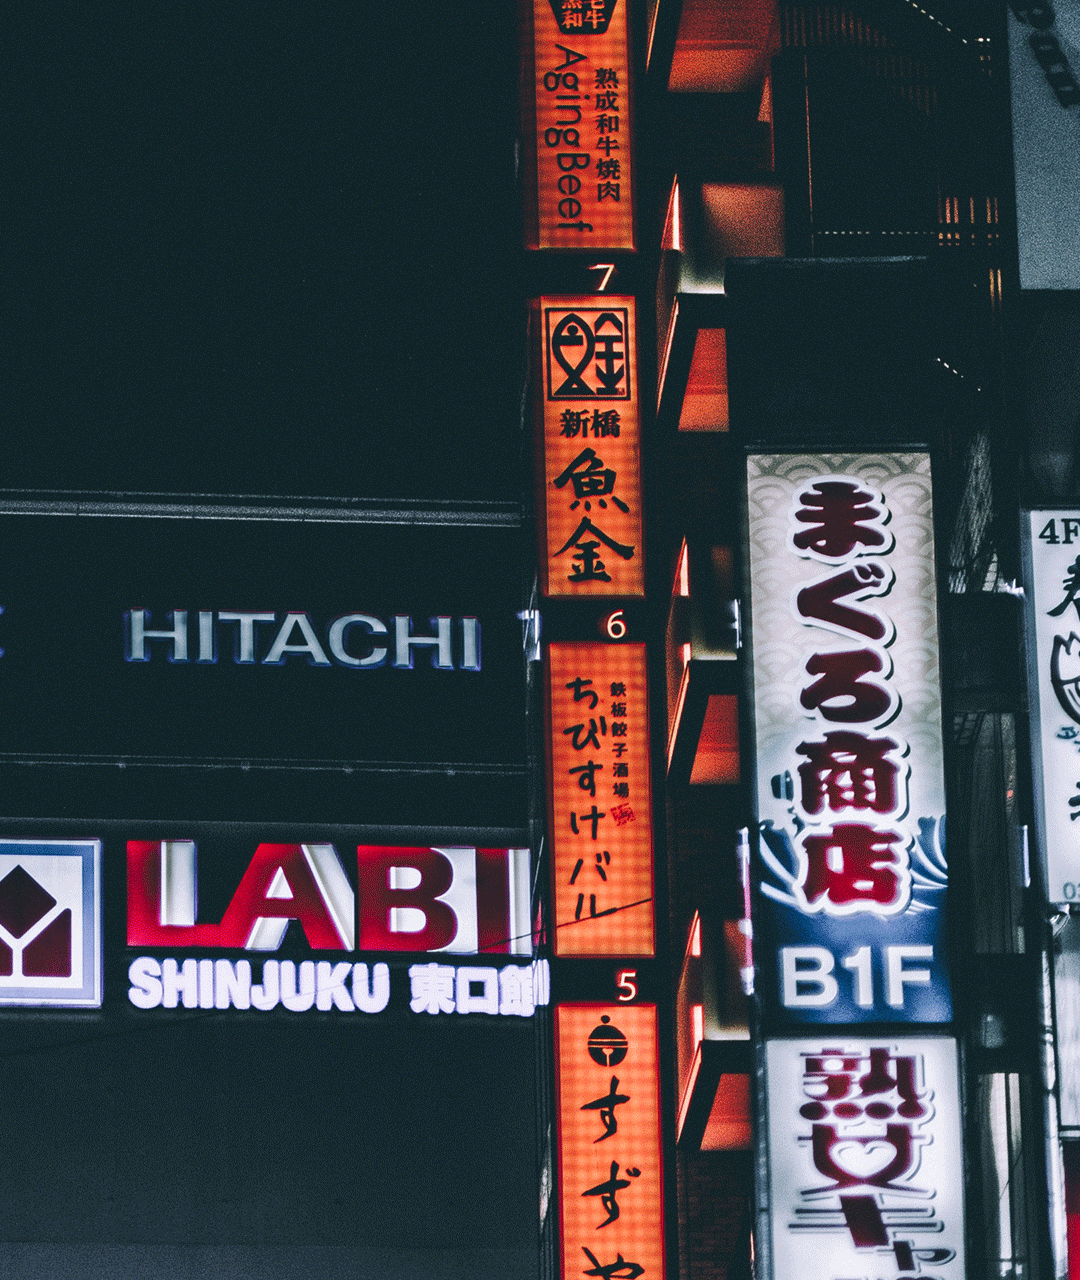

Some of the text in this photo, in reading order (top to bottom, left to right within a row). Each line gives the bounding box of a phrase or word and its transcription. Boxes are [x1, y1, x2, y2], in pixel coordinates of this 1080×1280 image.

[594, 67, 620, 202] 熟成和牛焼肉
[588, 263, 615, 292] 7
[559, 408, 621, 438] 新橋
[552, 446, 636, 583] 魚金
[125, 607, 482, 671] HITACHI
[606, 611, 627, 639] 6
[790, 479, 907, 912] まぐろ商店
[563, 677, 617, 921] ちびすけバル
[125, 838, 532, 955] LABI
[127, 957, 391, 1013] SHINJUKU
[618, 972, 637, 1001] 5
[779, 946, 934, 1008] B1F
